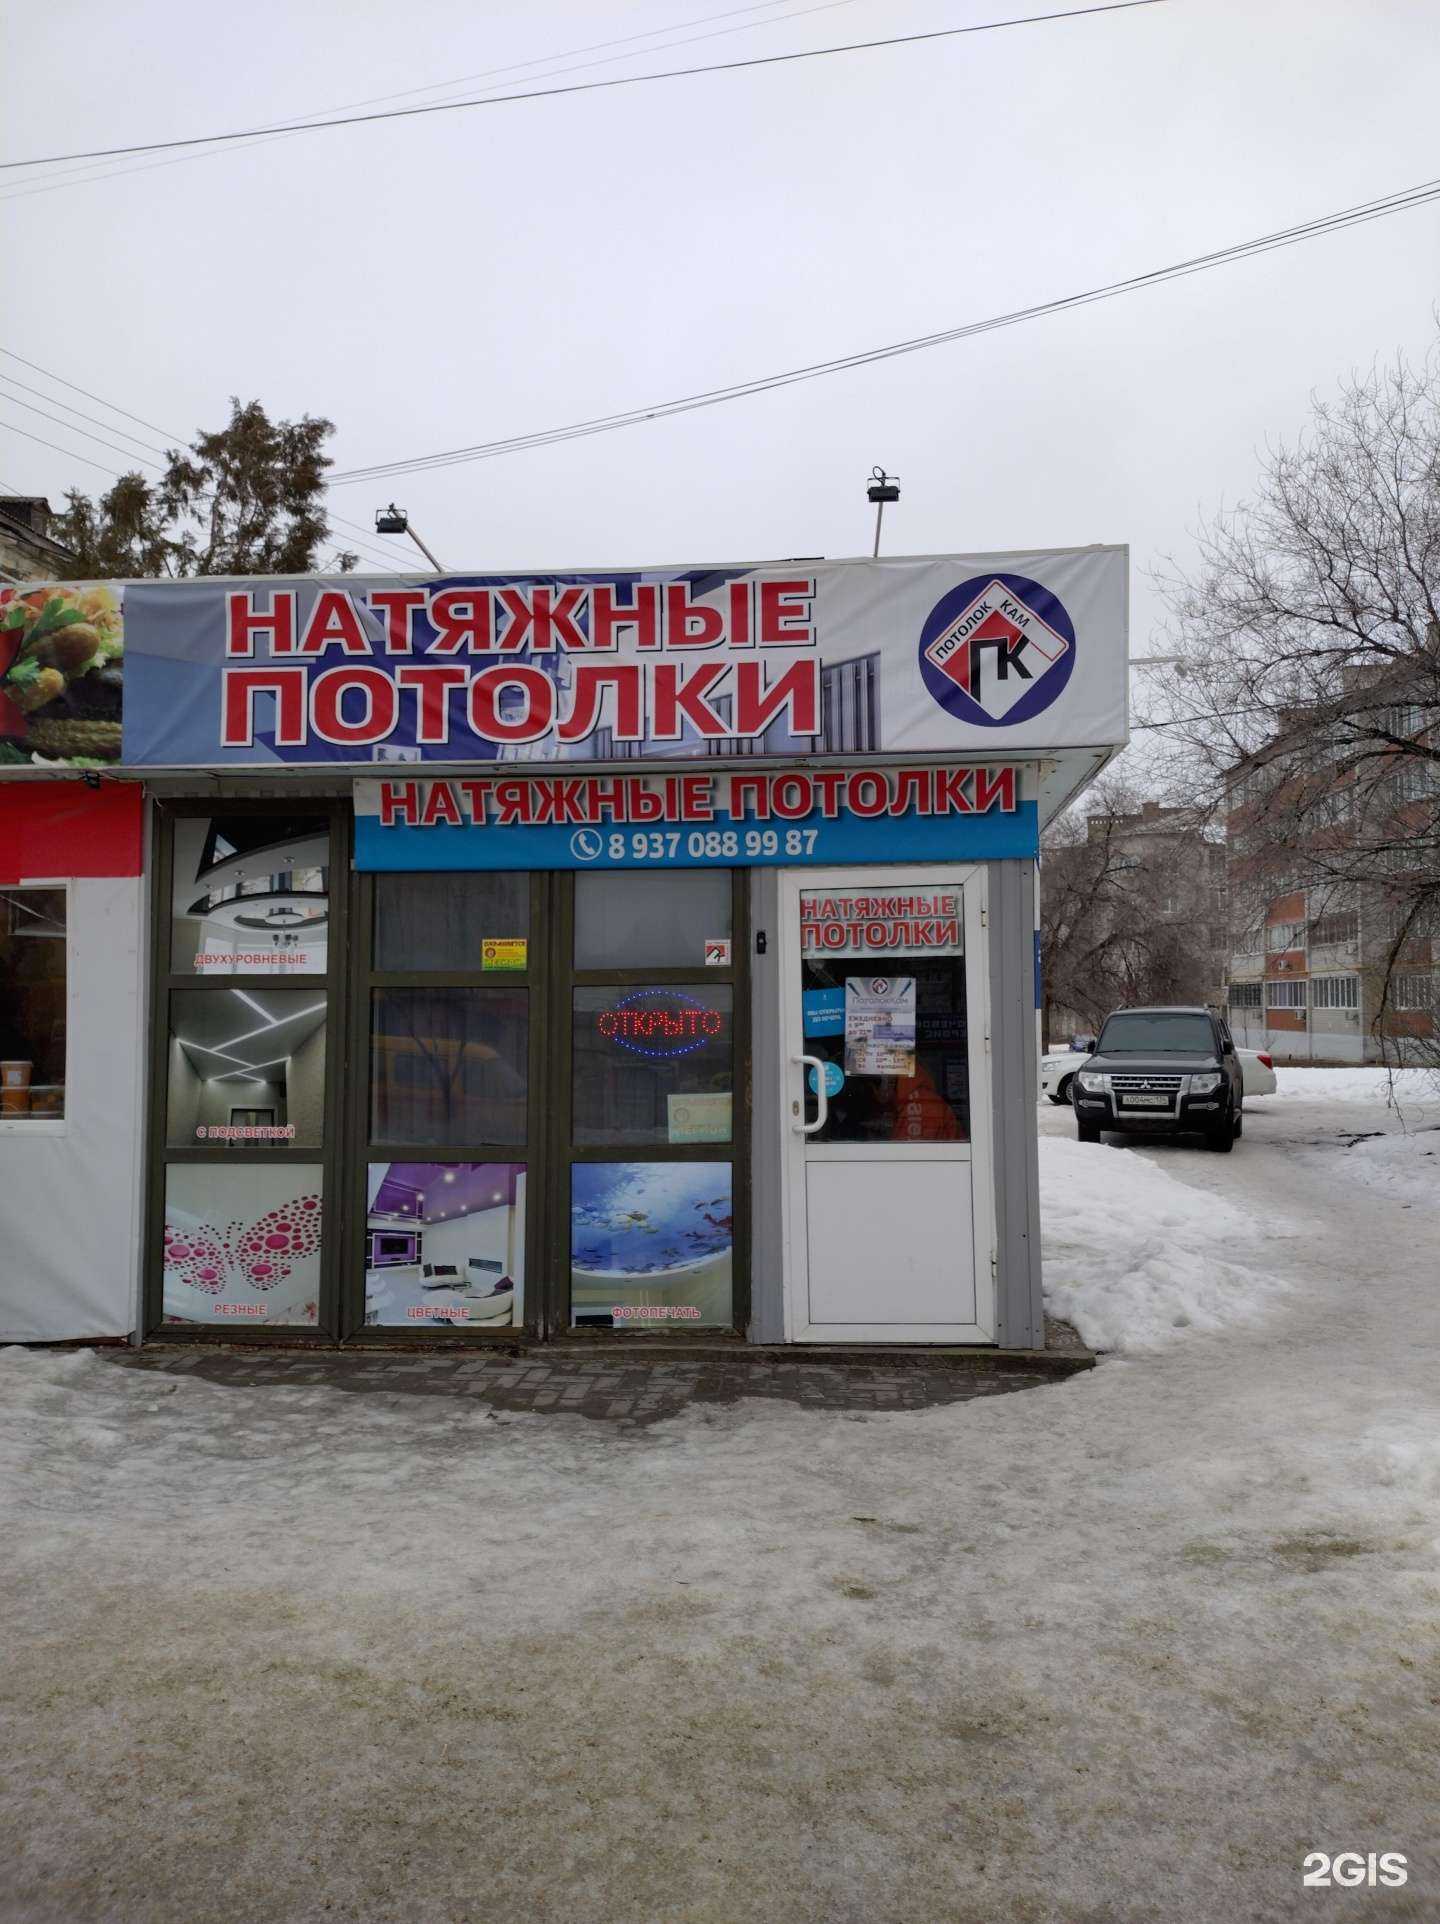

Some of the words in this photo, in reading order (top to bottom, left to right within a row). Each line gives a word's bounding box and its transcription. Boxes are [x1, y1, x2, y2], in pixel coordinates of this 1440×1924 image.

[226, 578, 816, 658] НАТЯЖНЫЕ
[935, 600, 993, 660] ПОТОЛОК
[1000, 599, 1031, 628] КАМ
[221, 659, 822, 747] ПОТОЛКИ
[379, 777, 713, 827] НАТЯЖНЫЕ
[729, 767, 1017, 821] ПОТОЛКИ
[608, 833, 625, 860] 8
[632, 832, 681, 859] 937
[688, 831, 739, 858] 088
[745, 830, 779, 857] 99
[785, 828, 819, 855] 87
[800, 895, 957, 920] НАТЯЖНЫЕ
[801, 919, 958, 948] ПОТОЛКИ
[194, 953, 308, 967] ДВУХУРОВНЕВЫЕ
[598, 1009, 722, 1036] ОТКРЫТО
[196, 1125, 207, 1138] С
[208, 1124, 296, 1140] ПОДСВЕТКОЙ
[213, 1304, 267, 1316] РЕЗНЫЕ
[407, 1306, 470, 1319] ЦВЕТНЫЕ
[612, 1306, 701, 1319] ФОТОПЕЧАТЬ
